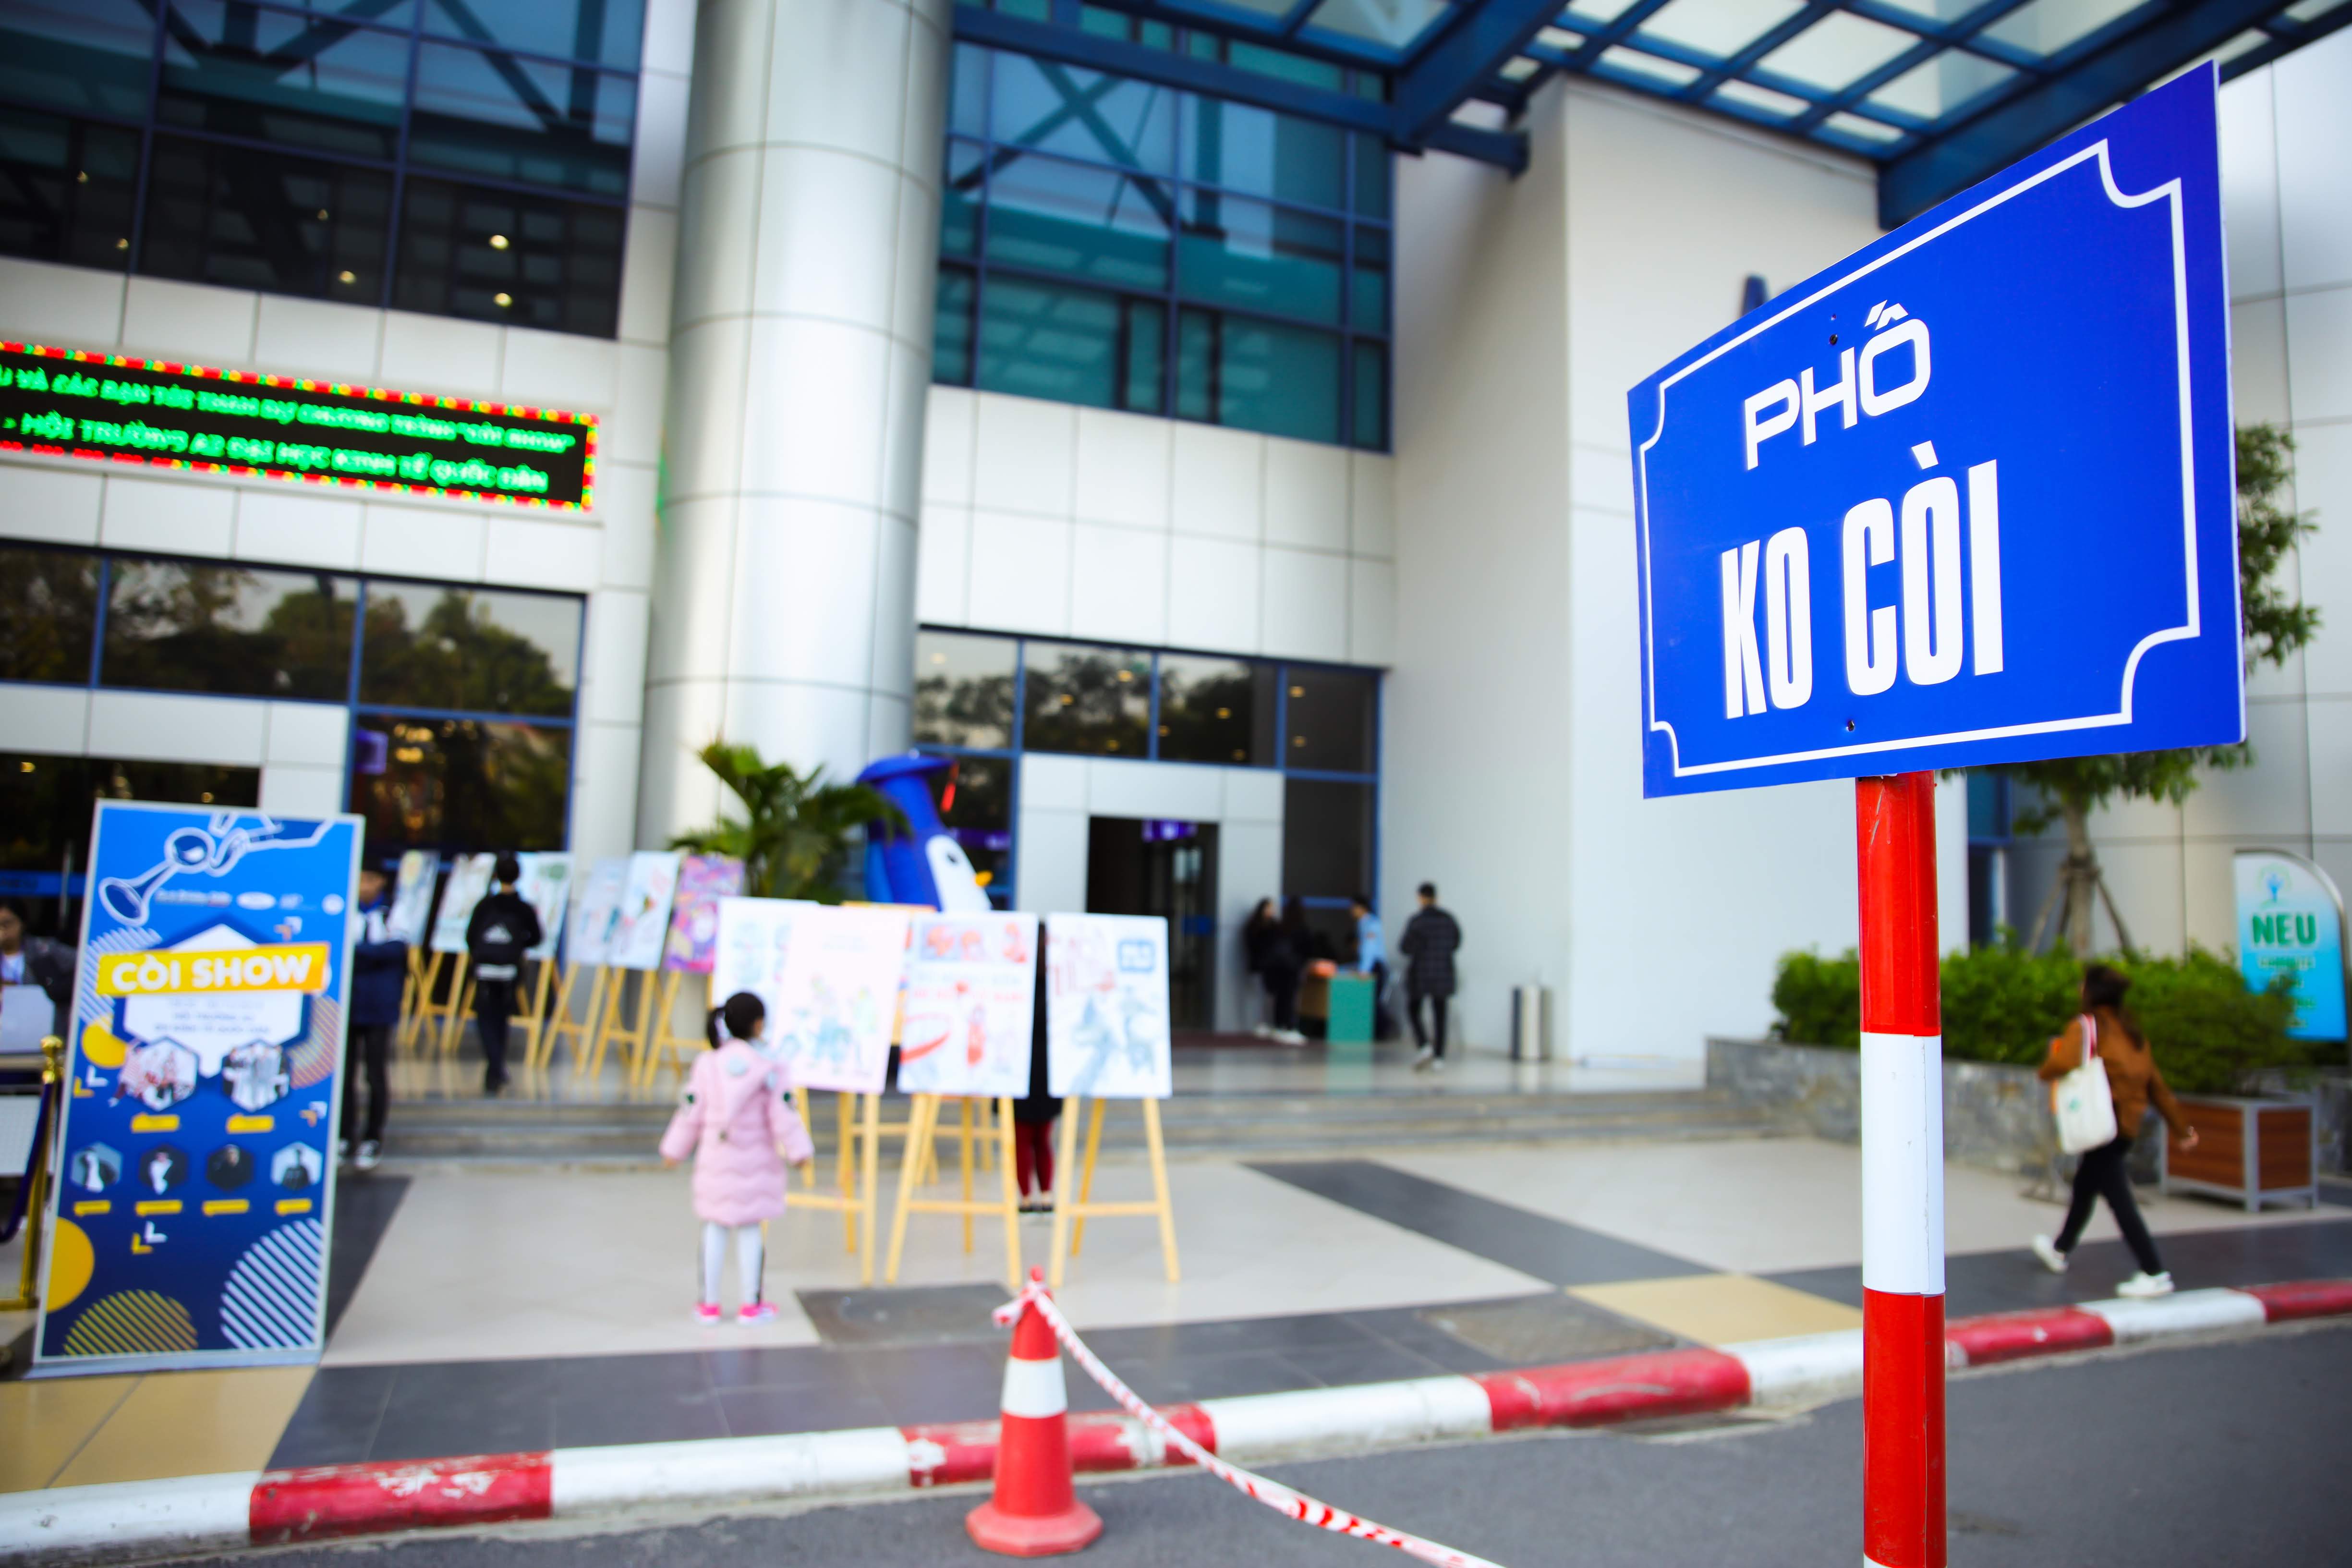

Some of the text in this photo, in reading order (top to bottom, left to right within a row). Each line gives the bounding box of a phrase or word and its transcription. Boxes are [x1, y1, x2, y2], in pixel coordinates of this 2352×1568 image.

[1745, 300, 1931, 471] PHỐ
[1722, 440, 2004, 720] KO CÒI
[111, 953, 313, 993] CÒI SHOW
[2251, 914, 2317, 946] NEU
